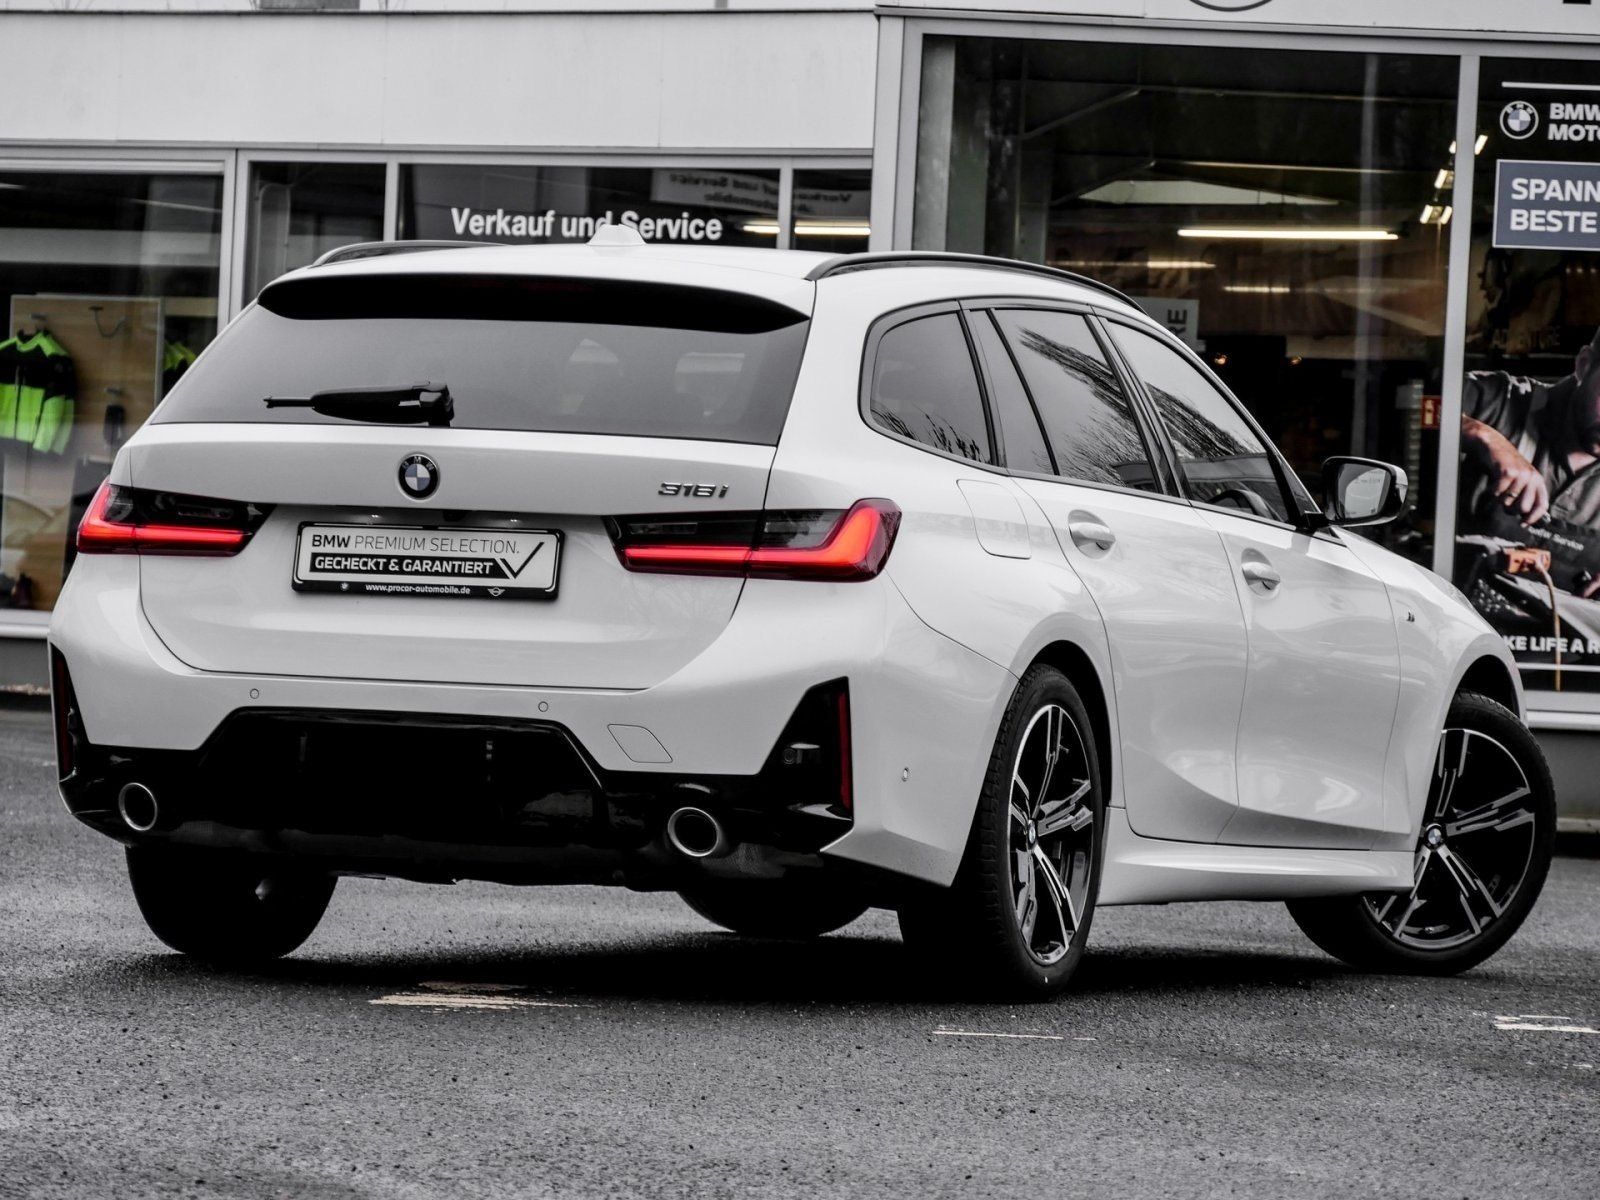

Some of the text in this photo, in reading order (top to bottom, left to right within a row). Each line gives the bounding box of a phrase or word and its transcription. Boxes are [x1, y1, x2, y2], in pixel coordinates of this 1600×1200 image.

[1550, 102, 1600, 121] BMW
[1548, 123, 1600, 142] MOT
[1511, 177, 1600, 203] SPANN
[451, 207, 556, 237] Verkauf
[621, 210, 722, 241] Service
[1510, 208, 1598, 234] BESTE
[658, 482, 729, 498] 318i
[311, 534, 520, 554] BMW PREMIUM SELECTION.
[315, 556, 494, 574] GECHECKT & GARANTIERT
[365, 584, 471, 595] www.procar-automobile.de
[1530, 636, 1569, 653] LIFE
[1570, 638, 1585, 654] A
